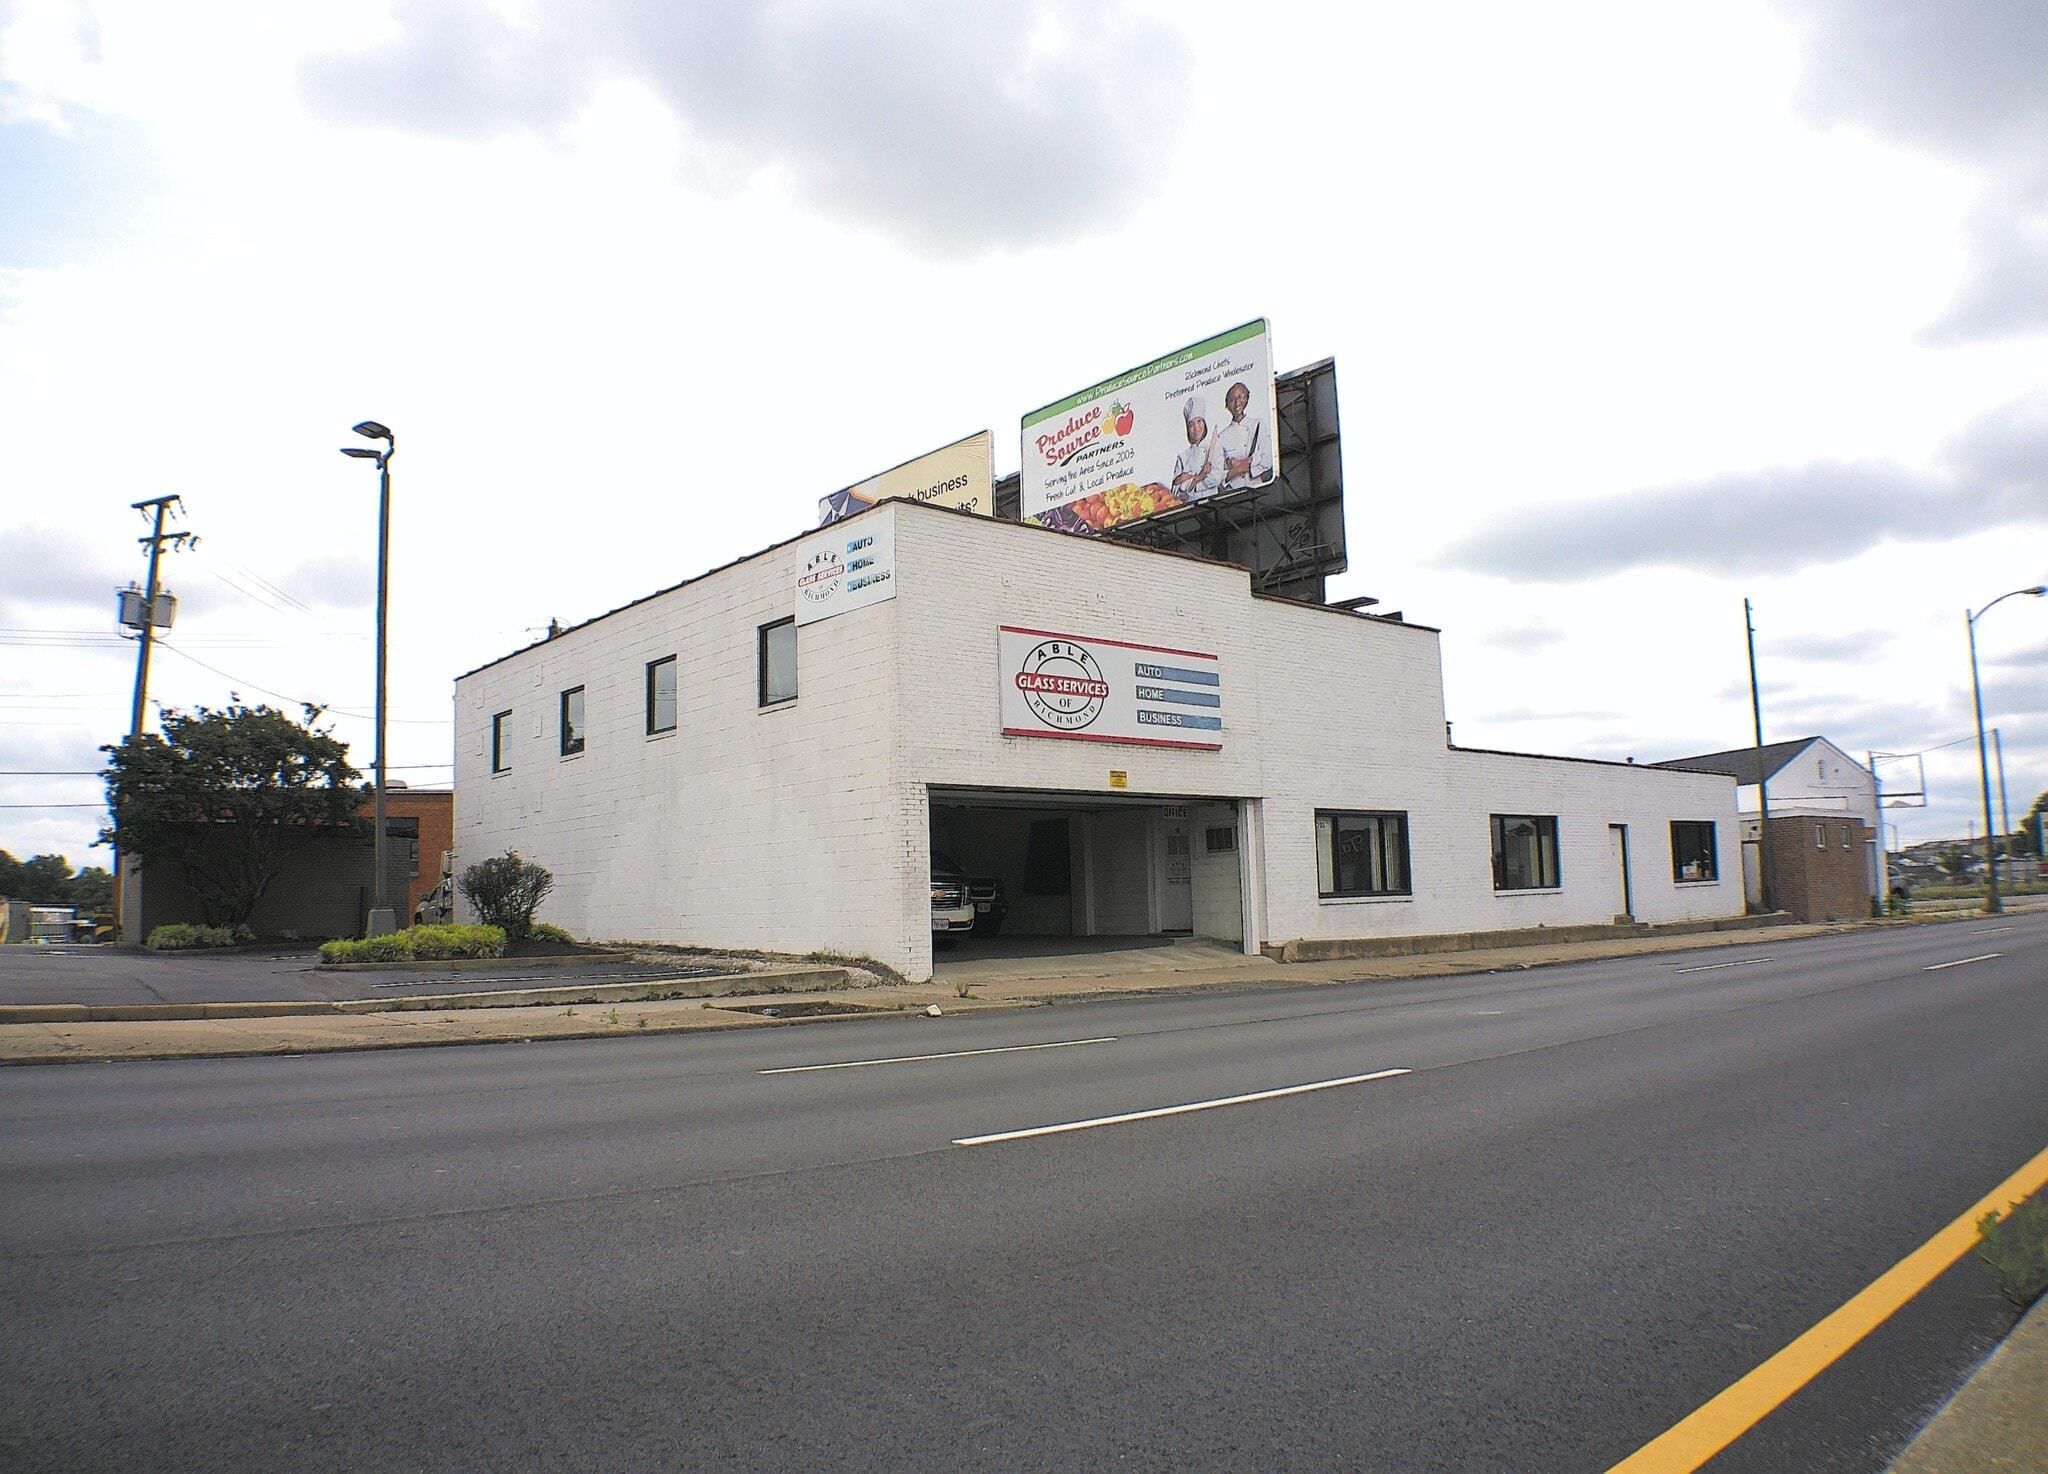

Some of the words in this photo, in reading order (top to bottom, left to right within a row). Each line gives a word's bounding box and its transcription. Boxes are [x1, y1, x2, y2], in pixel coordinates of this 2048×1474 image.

[1165, 383, 1195, 400] Preferred
[1196, 374, 1221, 388] Produce
[1222, 362, 1255, 378] Wholesaler
[1185, 363, 1212, 380] Richmond
[1035, 406, 1102, 454] Produce
[1045, 425, 1102, 467] Source
[1076, 440, 1125, 463] PARTNERS
[1044, 474, 1068, 489] Serving
[1067, 470, 1078, 481] the
[1080, 465, 1095, 476] Area
[1096, 458, 1114, 471] Since
[1116, 447, 1135, 463] 2003
[917, 474, 968, 502] business
[1045, 490, 1064, 502] Fresh
[1064, 485, 1077, 497] Cut
[1079, 481, 1086, 493] &
[1087, 474, 1105, 489] Local
[1106, 465, 1135, 481] Produce
[852, 536, 873, 552] AUTO
[807, 552, 837, 571] ABLE
[852, 556, 875, 571] HOME
[852, 569, 891, 591] BUSINESS
[1037, 643, 1088, 664] ABLE
[1137, 665, 1162, 678] AUTO
[1018, 675, 1055, 690] GLASS
[1057, 679, 1107, 696] SERVICES
[1138, 688, 1164, 700] HOME
[1033, 699, 1096, 725] RICHMOND
[1059, 698, 1072, 708] OF
[1140, 711, 1182, 726] BUSINESS
[1163, 807, 1187, 817] OFFICE
